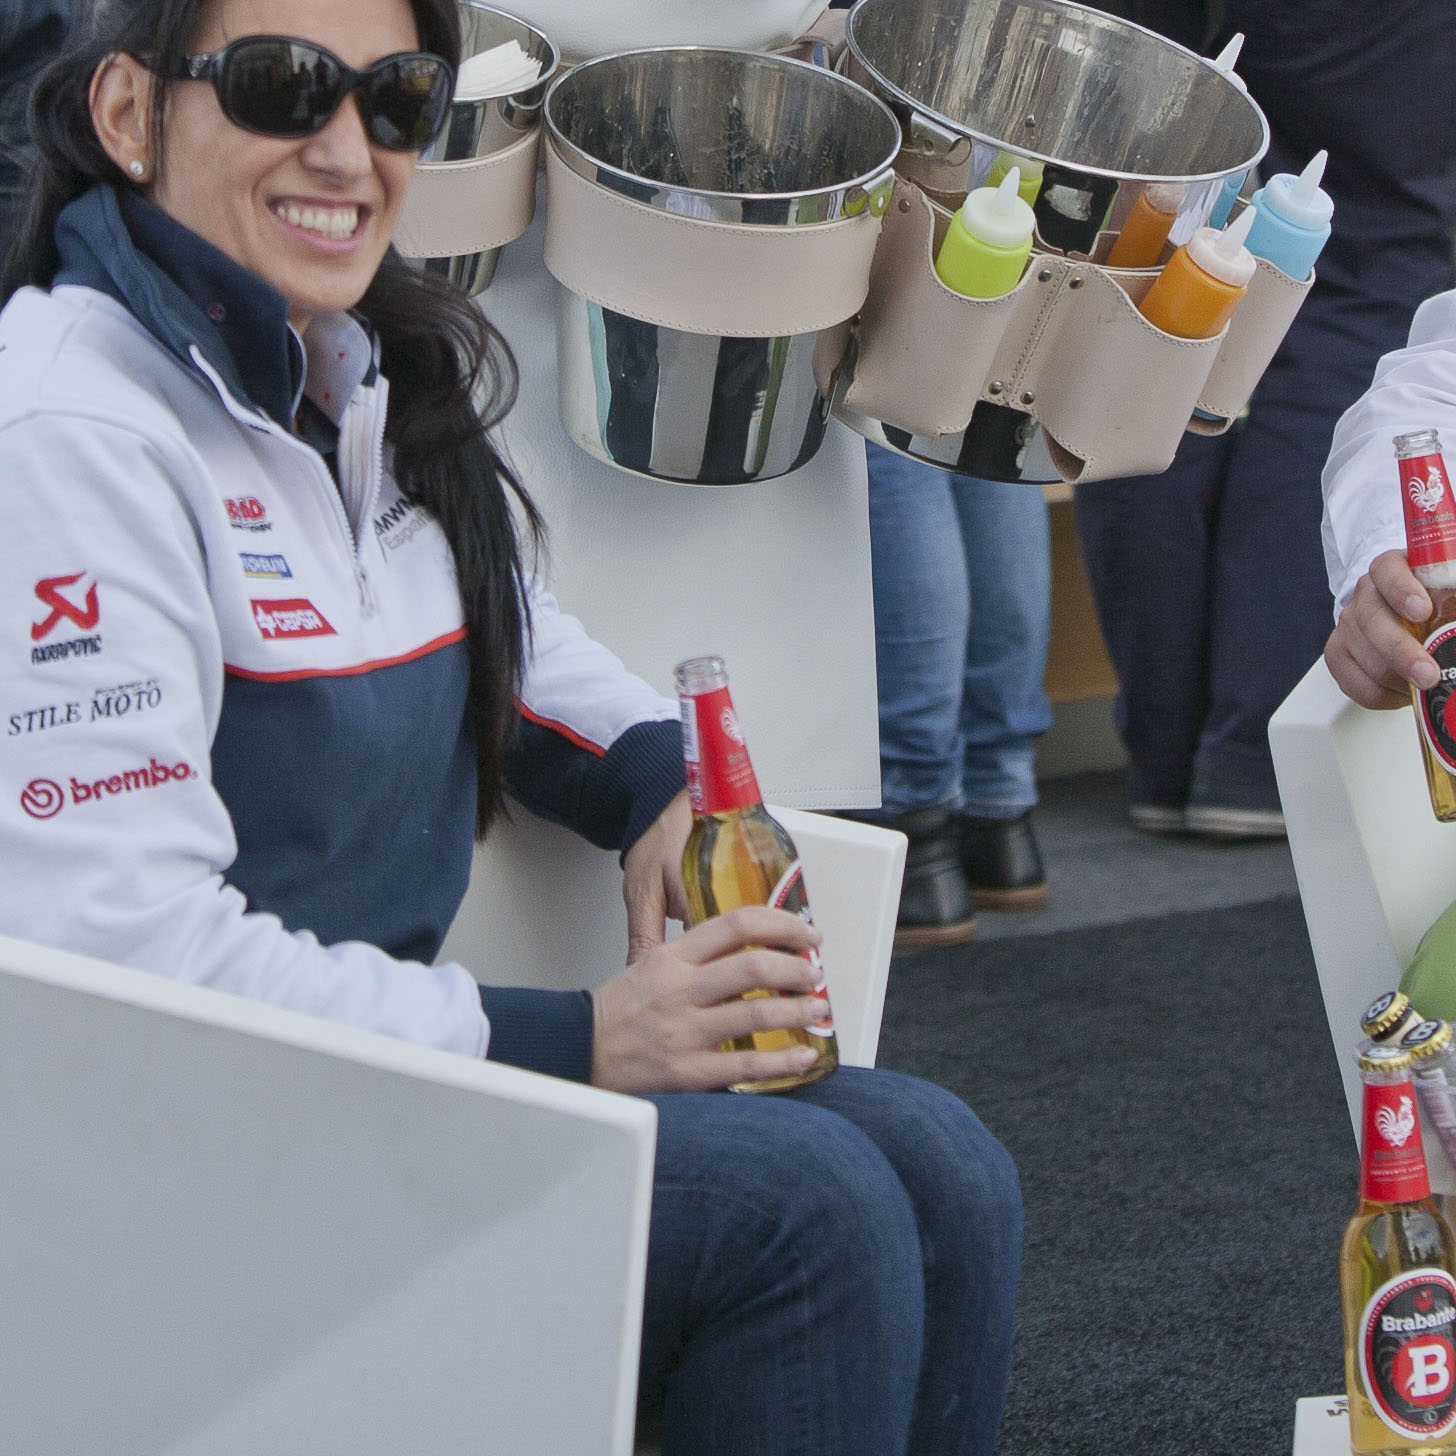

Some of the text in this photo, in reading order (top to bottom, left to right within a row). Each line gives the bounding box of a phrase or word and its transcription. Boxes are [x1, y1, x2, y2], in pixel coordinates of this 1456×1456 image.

[8, 702, 82, 736] STILE
[90, 687, 162, 723] MOTO
[69, 757, 191, 804] brembo
[1406, 1344, 1450, 1398] B
